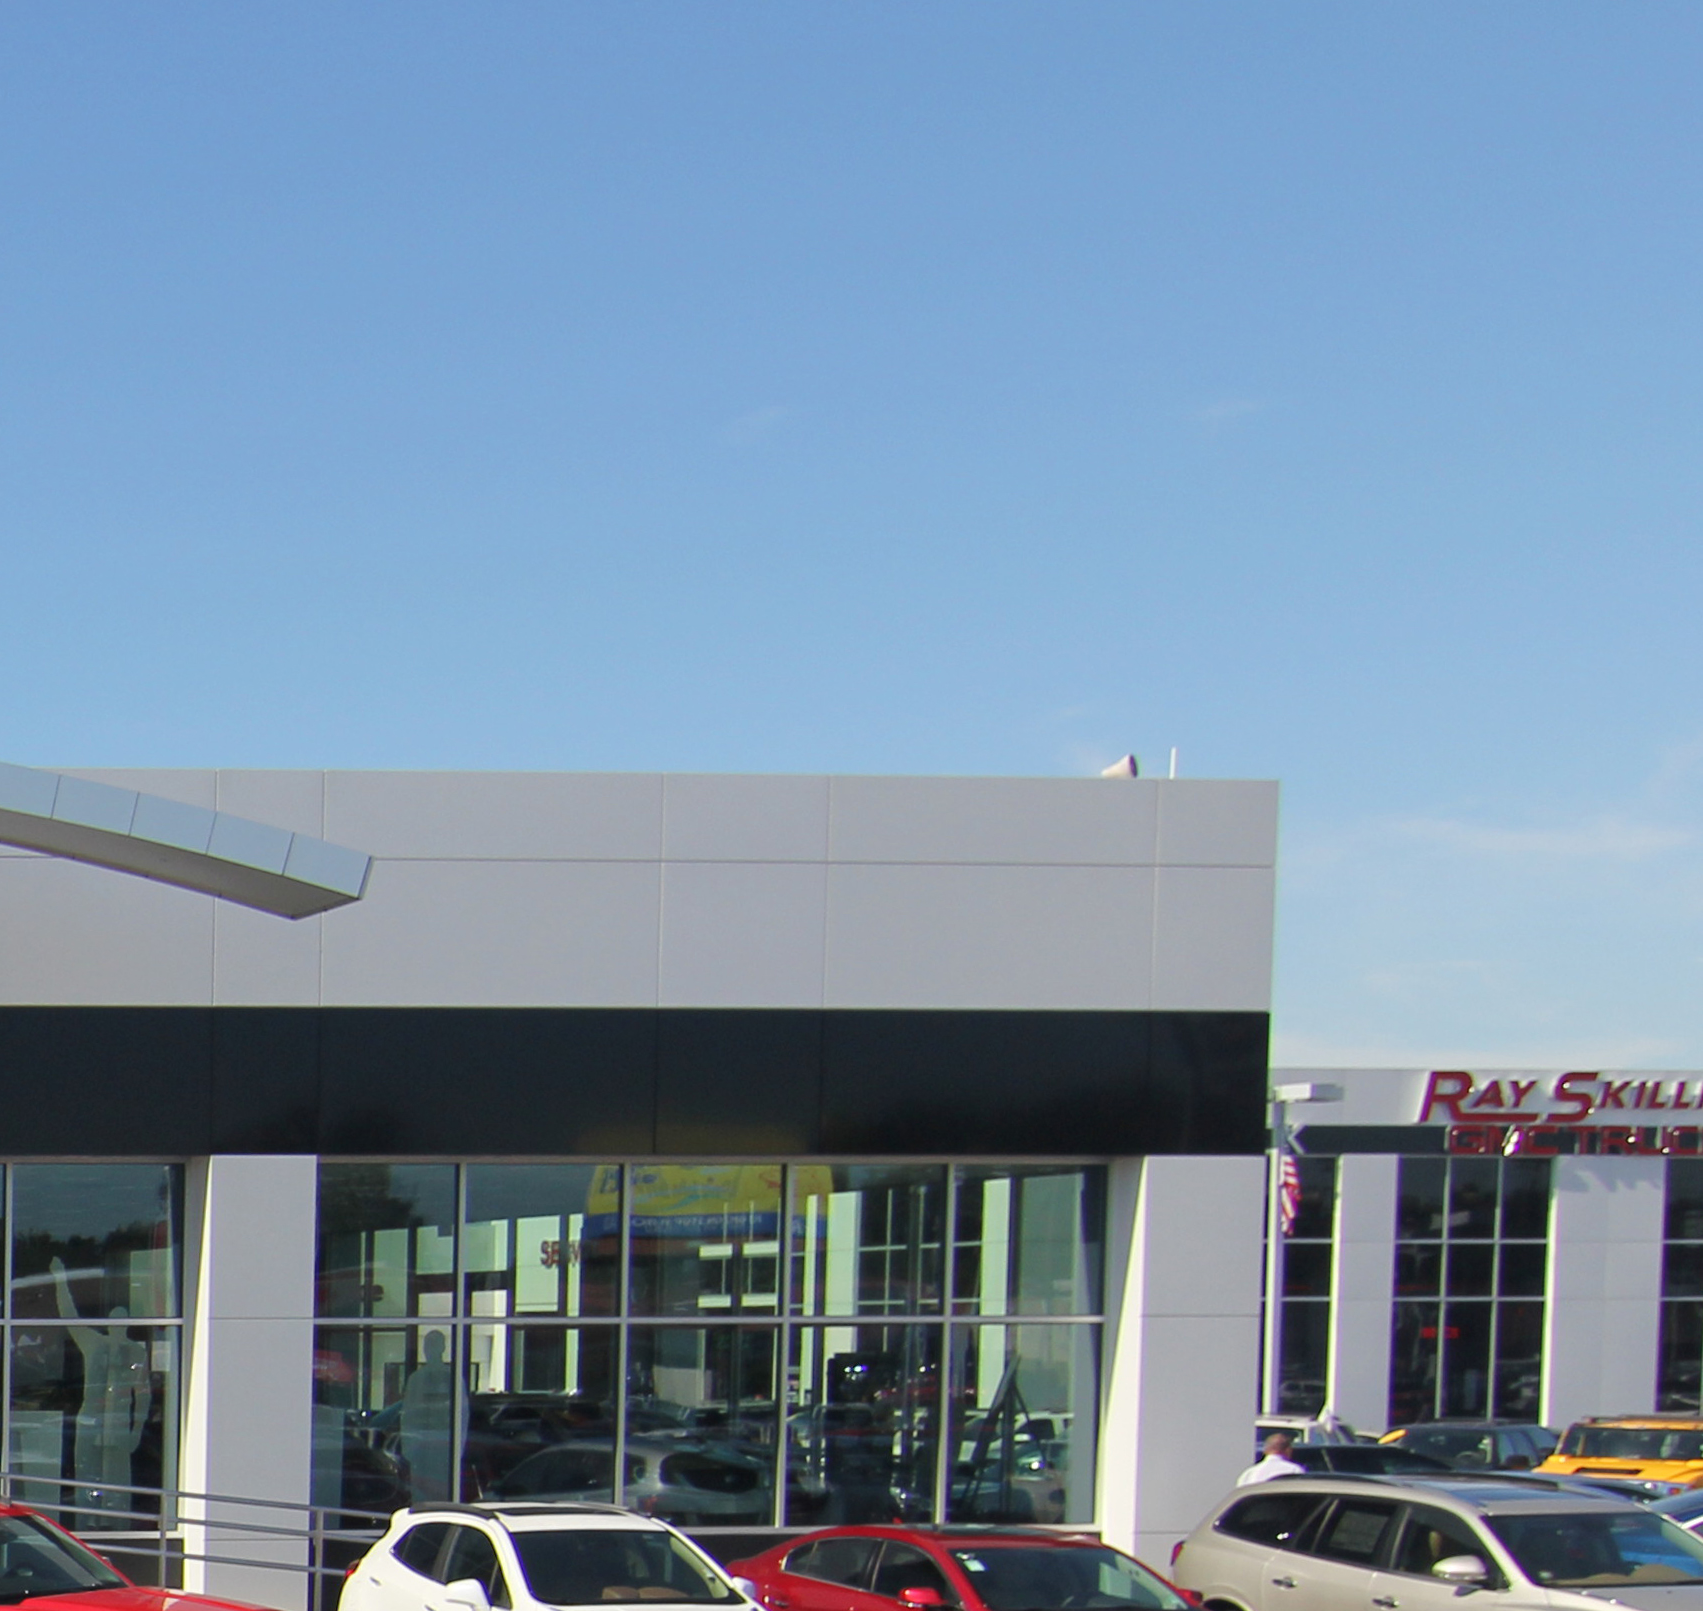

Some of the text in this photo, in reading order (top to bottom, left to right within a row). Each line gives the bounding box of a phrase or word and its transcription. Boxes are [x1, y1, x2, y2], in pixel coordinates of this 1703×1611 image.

[1417, 1071, 1703, 1123] RAY SKILL
[1448, 1125, 1703, 1156] GMC TRUC
